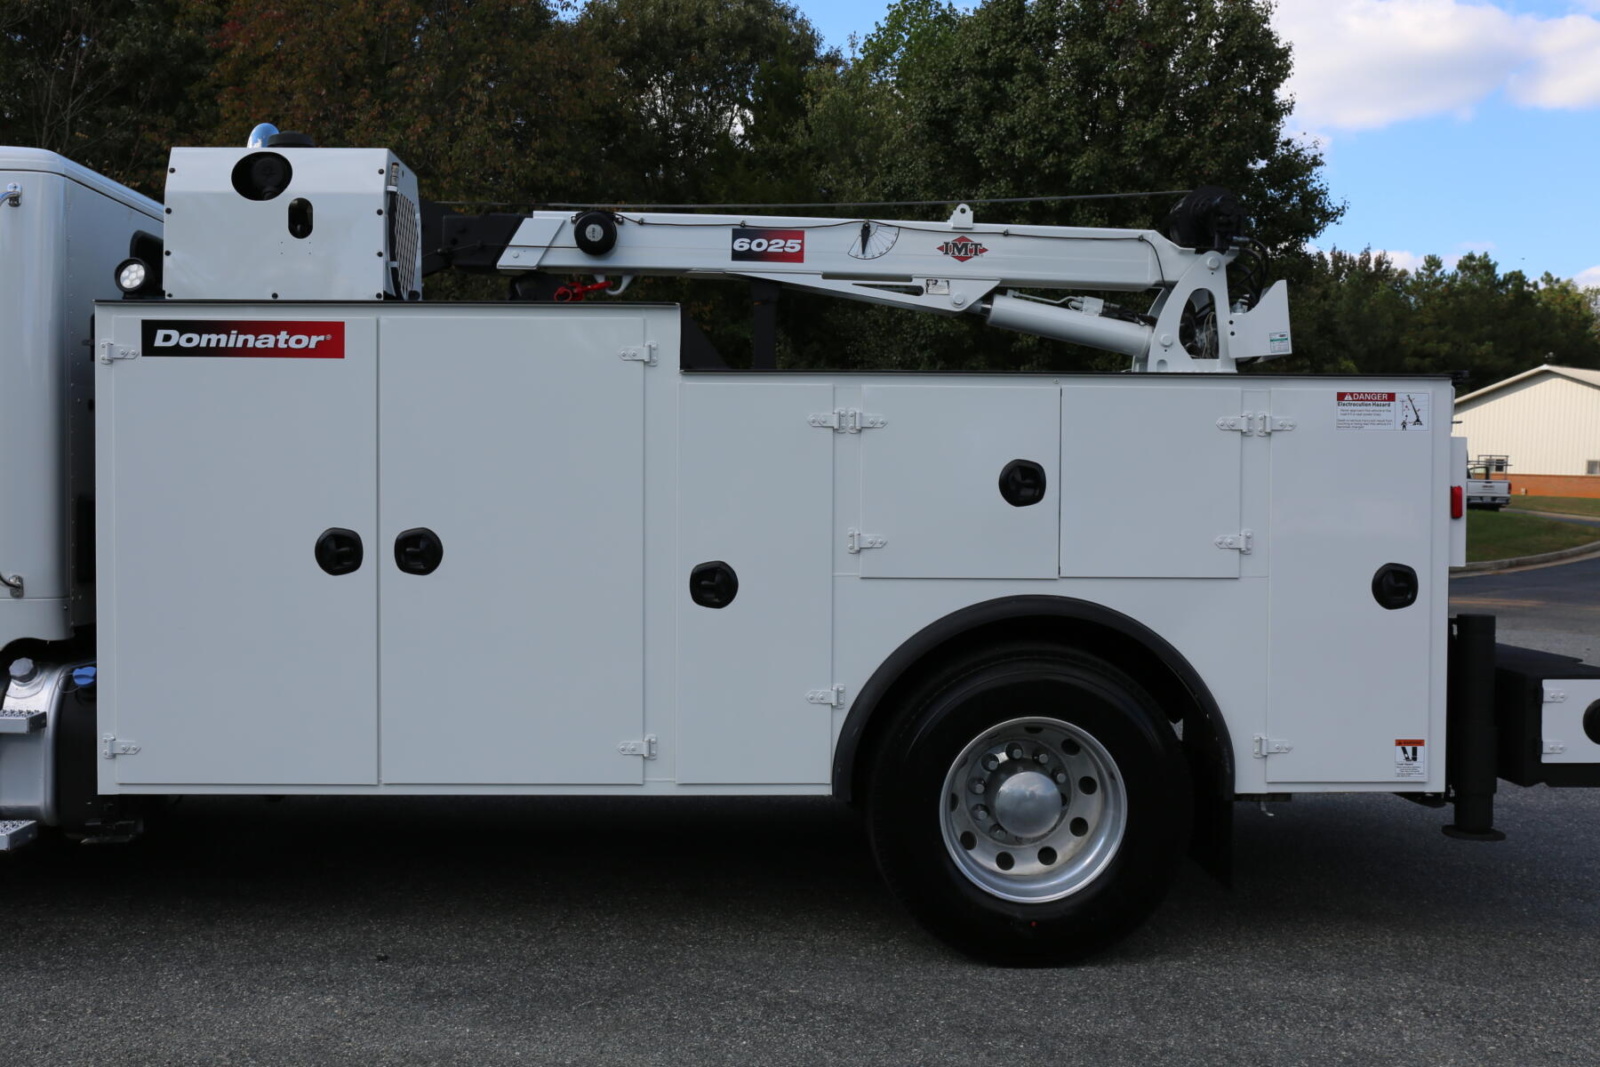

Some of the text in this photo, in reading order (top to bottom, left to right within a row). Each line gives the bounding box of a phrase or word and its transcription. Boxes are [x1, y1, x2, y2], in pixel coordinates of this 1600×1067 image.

[733, 237, 802, 253] 6025
[943, 241, 983, 257] IMT
[153, 329, 325, 349] Dominator
[1353, 393, 1388, 401] DANGER
